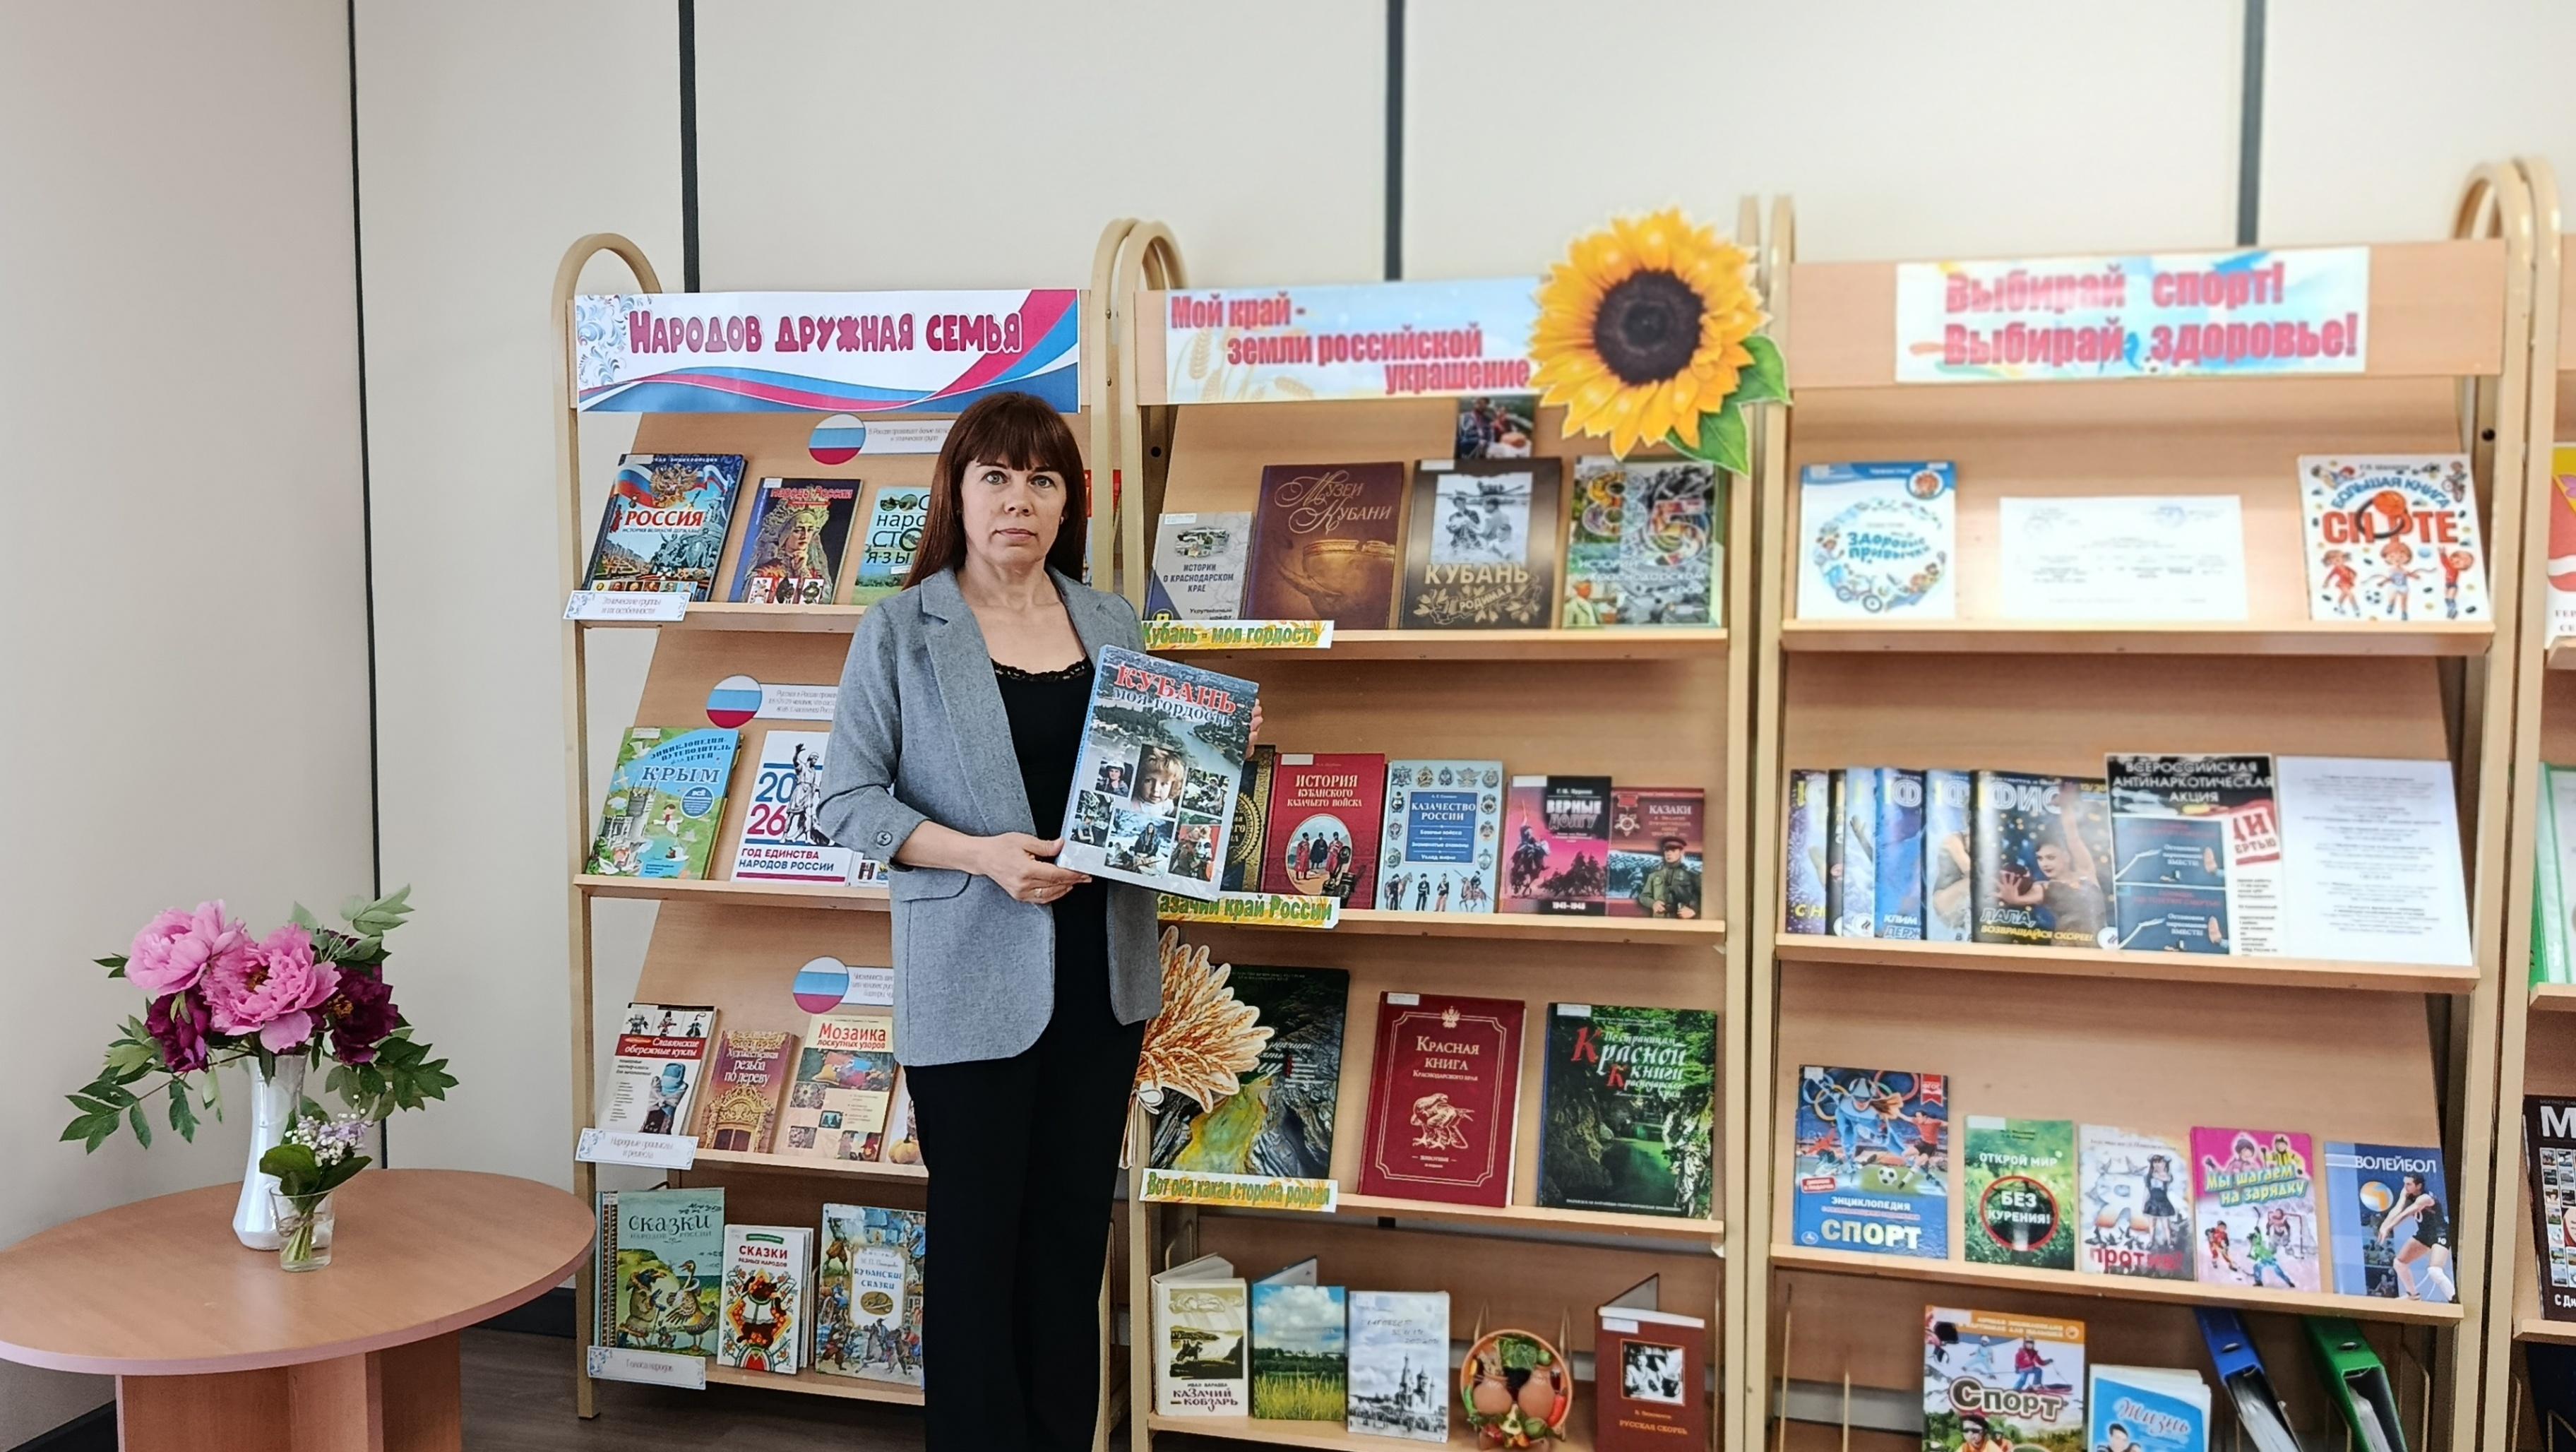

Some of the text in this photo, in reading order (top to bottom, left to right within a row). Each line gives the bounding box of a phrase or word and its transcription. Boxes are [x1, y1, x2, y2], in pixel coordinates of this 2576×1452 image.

[1945, 262, 2284, 314] Выбирай спорт!
[1171, 293, 1223, 328] Мой
[1229, 292, 1291, 330] край
[1227, 322, 1482, 366] земли российской
[1944, 313, 2358, 367] Выбирай здоровье!
[1385, 358, 1530, 394] украшение
[2332, 477, 2451, 510] БОЛЬШАЯ КНИГА
[625, 511, 704, 525] РОССИЯ
[876, 515, 926, 530] наро
[1171, 573, 1234, 583] КРАСНОДАРСКОМ
[1424, 566, 1530, 585] КУБАНЬ
[1459, 585, 1513, 612] РОДИМАЯ
[1143, 622, 1198, 647] Кубань
[1211, 629, 1242, 644] моя
[1246, 626, 1319, 646] гордость
[1114, 665, 1236, 715] КУБАНЬ
[1113, 687, 1234, 728] моя гордость
[642, 767, 720, 782] КРЫМ
[2125, 761, 2258, 774] ВСЕРОССИЙСКАЯ
[755, 772, 798, 804] 20
[1295, 775, 1357, 787] ИСТОРИЯ
[2113, 775, 2274, 789] АНТИНАРКОТИЧЕСКАЯ
[1298, 789, 1353, 798] КУБАНСКОГО
[2169, 792, 2219, 803] АКЦИЯ
[1332, 797, 1362, 807] ВОЙСКА
[1546, 800, 1602, 814] ВЕРНЫЕ
[1649, 805, 1691, 814] КАЗАКИ
[747, 804, 787, 836] 26
[1421, 812, 1464, 821] РОССИИ
[1549, 814, 1598, 830] ДОЛГУ
[741, 848, 819, 859] ГОД ЕДИНСТВА
[2234, 838, 2277, 854] ЕРТЬЮ
[739, 859, 834, 871] НАРОДОВ РОССИИ
[1157, 894, 1332, 920] азачий край России
[1883, 926, 1921, 939] ДЕРЖ
[2054, 932, 2094, 941] СКОРЕЕ!
[818, 1023, 886, 1042] Мозаика
[816, 1039, 886, 1050] лоскутных узоров
[1570, 1027, 1688, 1076] Красной
[672, 1049, 697, 1057] куклы
[732, 1059, 766, 1072] резьба
[724, 1071, 770, 1087] по дереву
[1979, 1152, 2058, 1167] ОТКРОЙ МИР
[2356, 1155, 2437, 1174] ВОЛЕЙБОЛ
[2205, 1165, 2296, 1191] Мы шагаем
[1147, 1172, 1330, 1205] Вот она какая сторона родная
[2222, 1181, 2306, 1204] на зарядку
[1831, 1196, 1911, 1211] ЭНЦИКЛОПЕДИЯ
[2000, 1191, 2037, 1208] БЕЗ
[1988, 1210, 2051, 1224] КУРЕНИЯ!
[629, 1215, 710, 1235] Сказки
[1821, 1219, 1922, 1249] СПОРТ
[739, 1245, 788, 1259] СКАЗКИ
[861, 1280, 895, 1290] СКАЗКИ
[1173, 1388, 1232, 1397] КАЗАЧИЙ
[1952, 1379, 2063, 1420] Спорт
[1183, 1398, 1238, 1412] КОБЗАРЬ
[2120, 1399, 2190, 1434] Жизнь
[1619, 1420, 1688, 1435] РУССКАЯ СКОРБЬ
